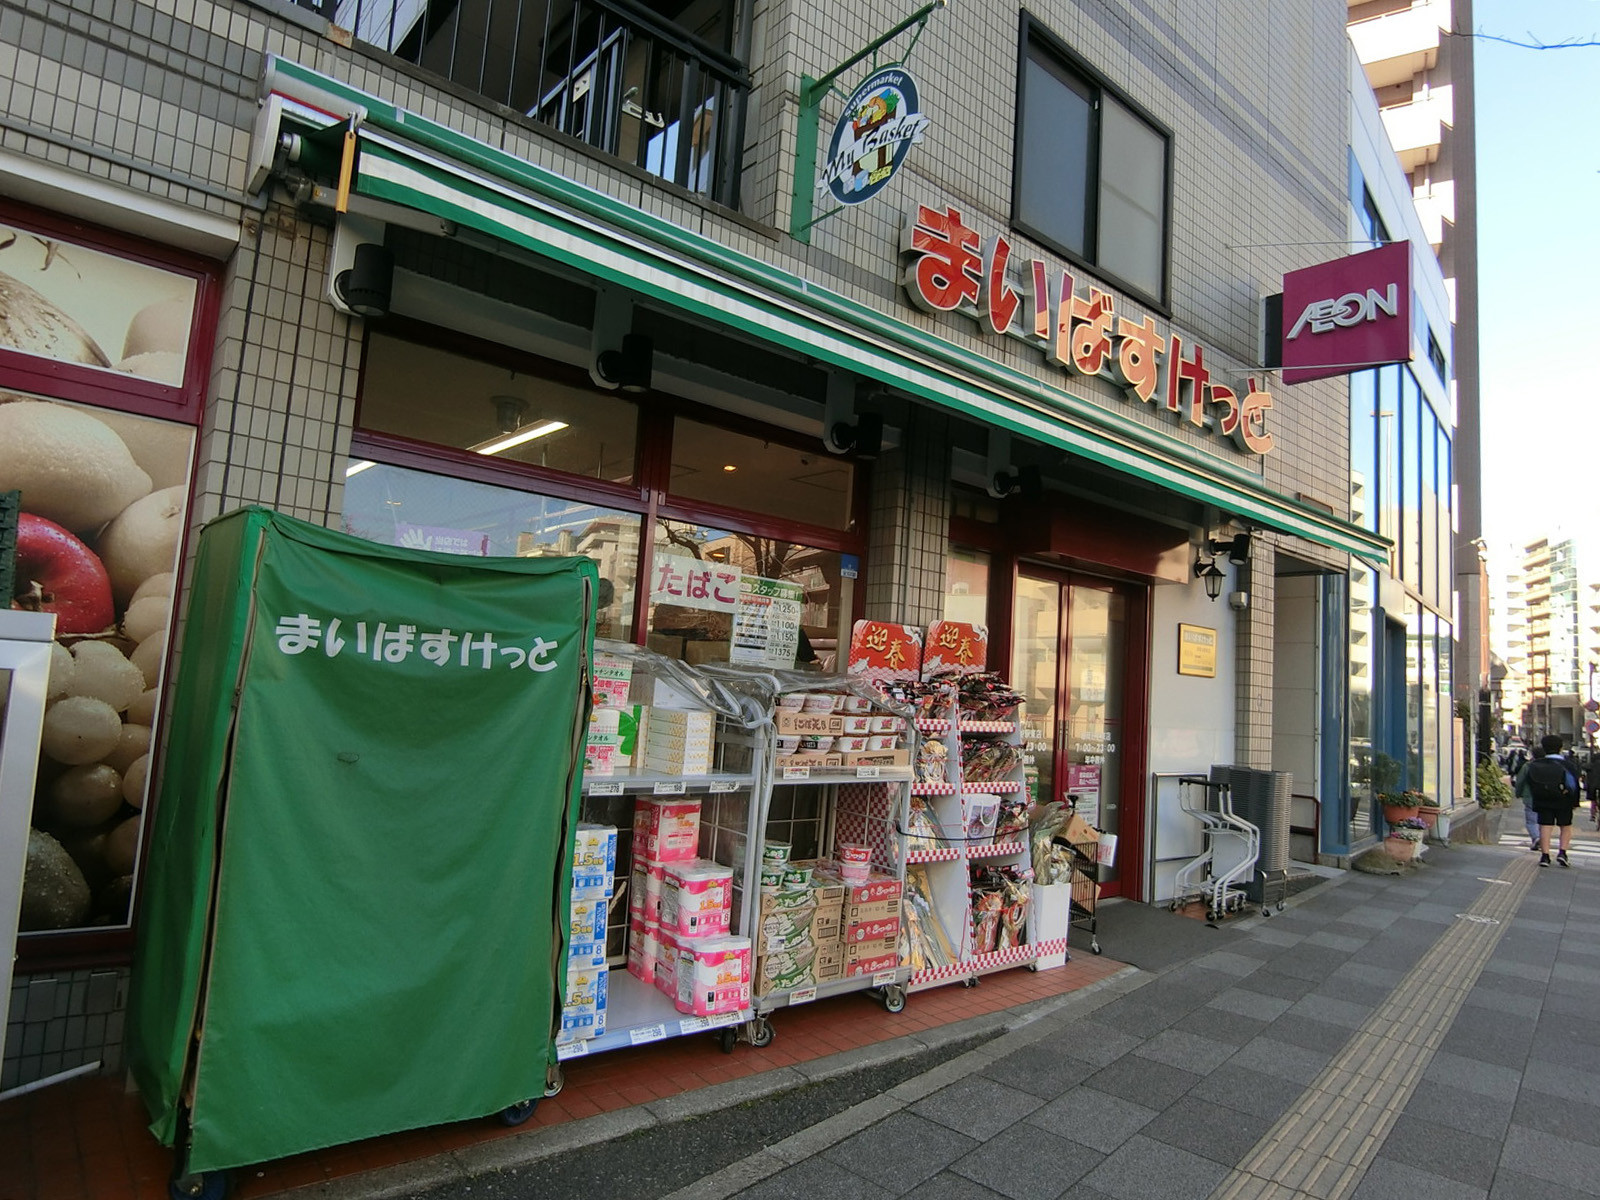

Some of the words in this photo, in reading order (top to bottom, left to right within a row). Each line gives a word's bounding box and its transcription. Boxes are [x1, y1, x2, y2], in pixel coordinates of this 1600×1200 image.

[844, 72, 904, 118] supermarket
[822, 148, 855, 183] My
[863, 116, 921, 151] Basket
[907, 202, 1276, 456] まいばすけっと
[1286, 283, 1398, 340] AEON
[657, 563, 736, 604] たばこ
[275, 613, 559, 673] まいばすけっと
[865, 625, 906, 670] 迎春
[939, 624, 974, 666] 迎春
[598, 1015, 604, 1025] 8
